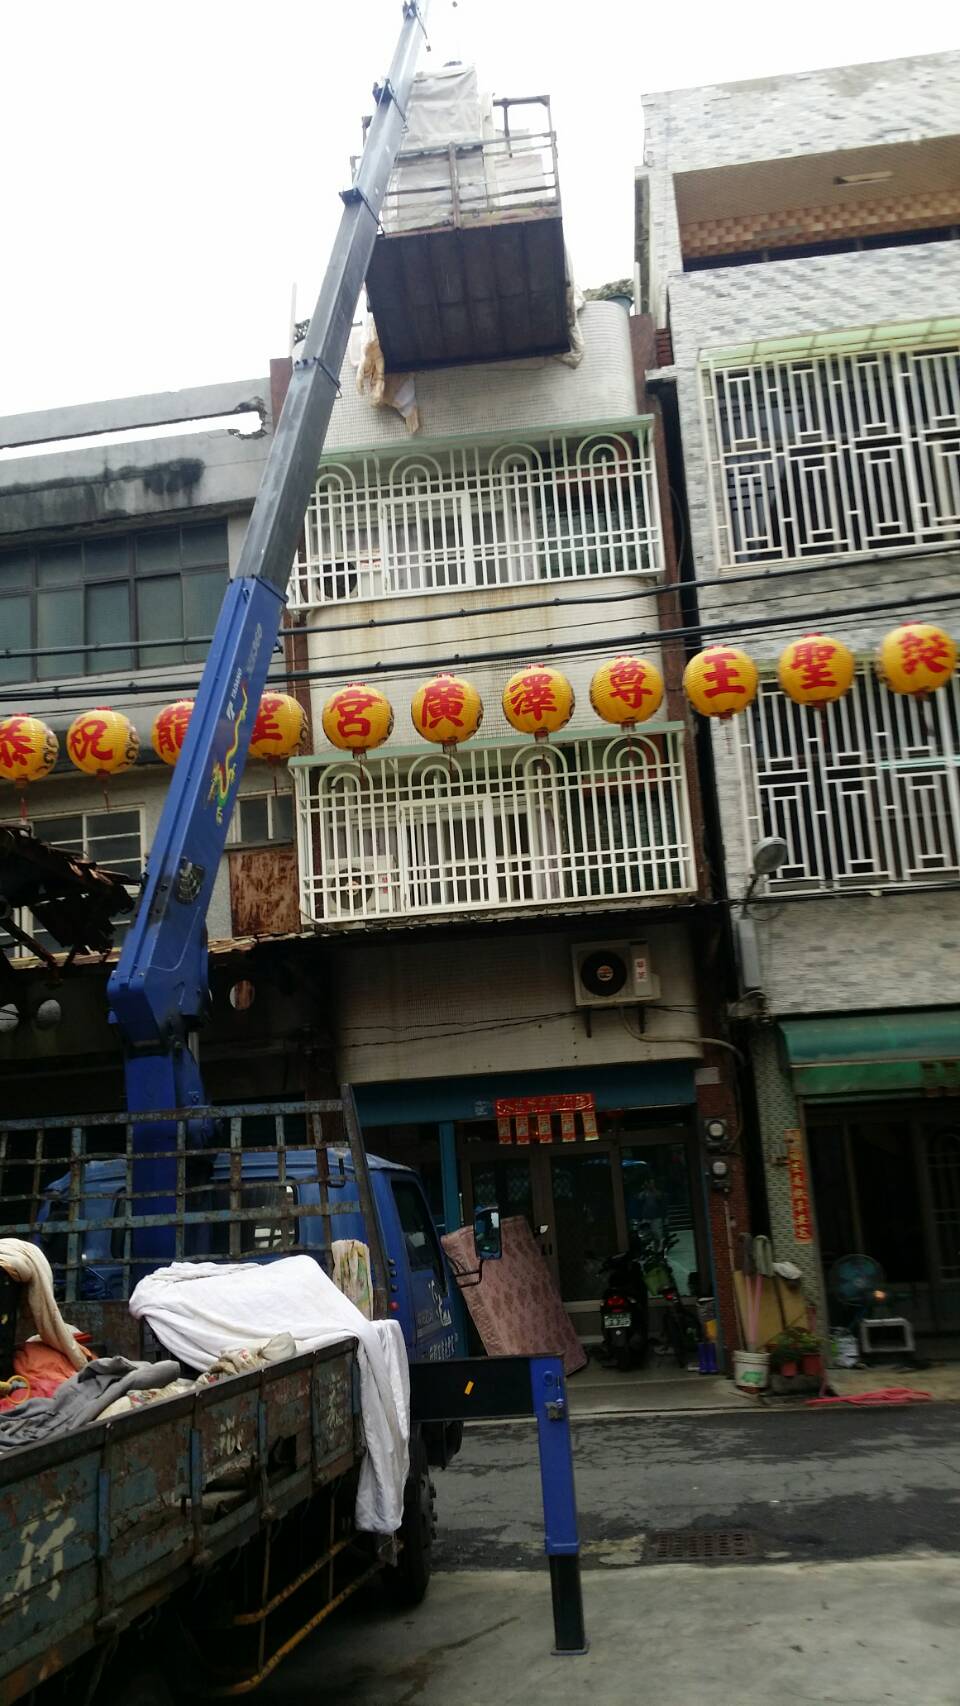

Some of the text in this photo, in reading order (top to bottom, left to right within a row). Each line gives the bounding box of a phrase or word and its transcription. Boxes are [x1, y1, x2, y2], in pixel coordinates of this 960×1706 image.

[0, 719, 36, 768] 恭
[70, 717, 113, 762] 祝
[331, 689, 382, 738] 宮
[422, 681, 465, 729] 廣
[510, 674, 557, 721] 澤
[609, 660, 653, 709] 尊
[703, 652, 746, 698] 王
[791, 642, 837, 689] 聖
[898, 632, 949, 674] 誕
